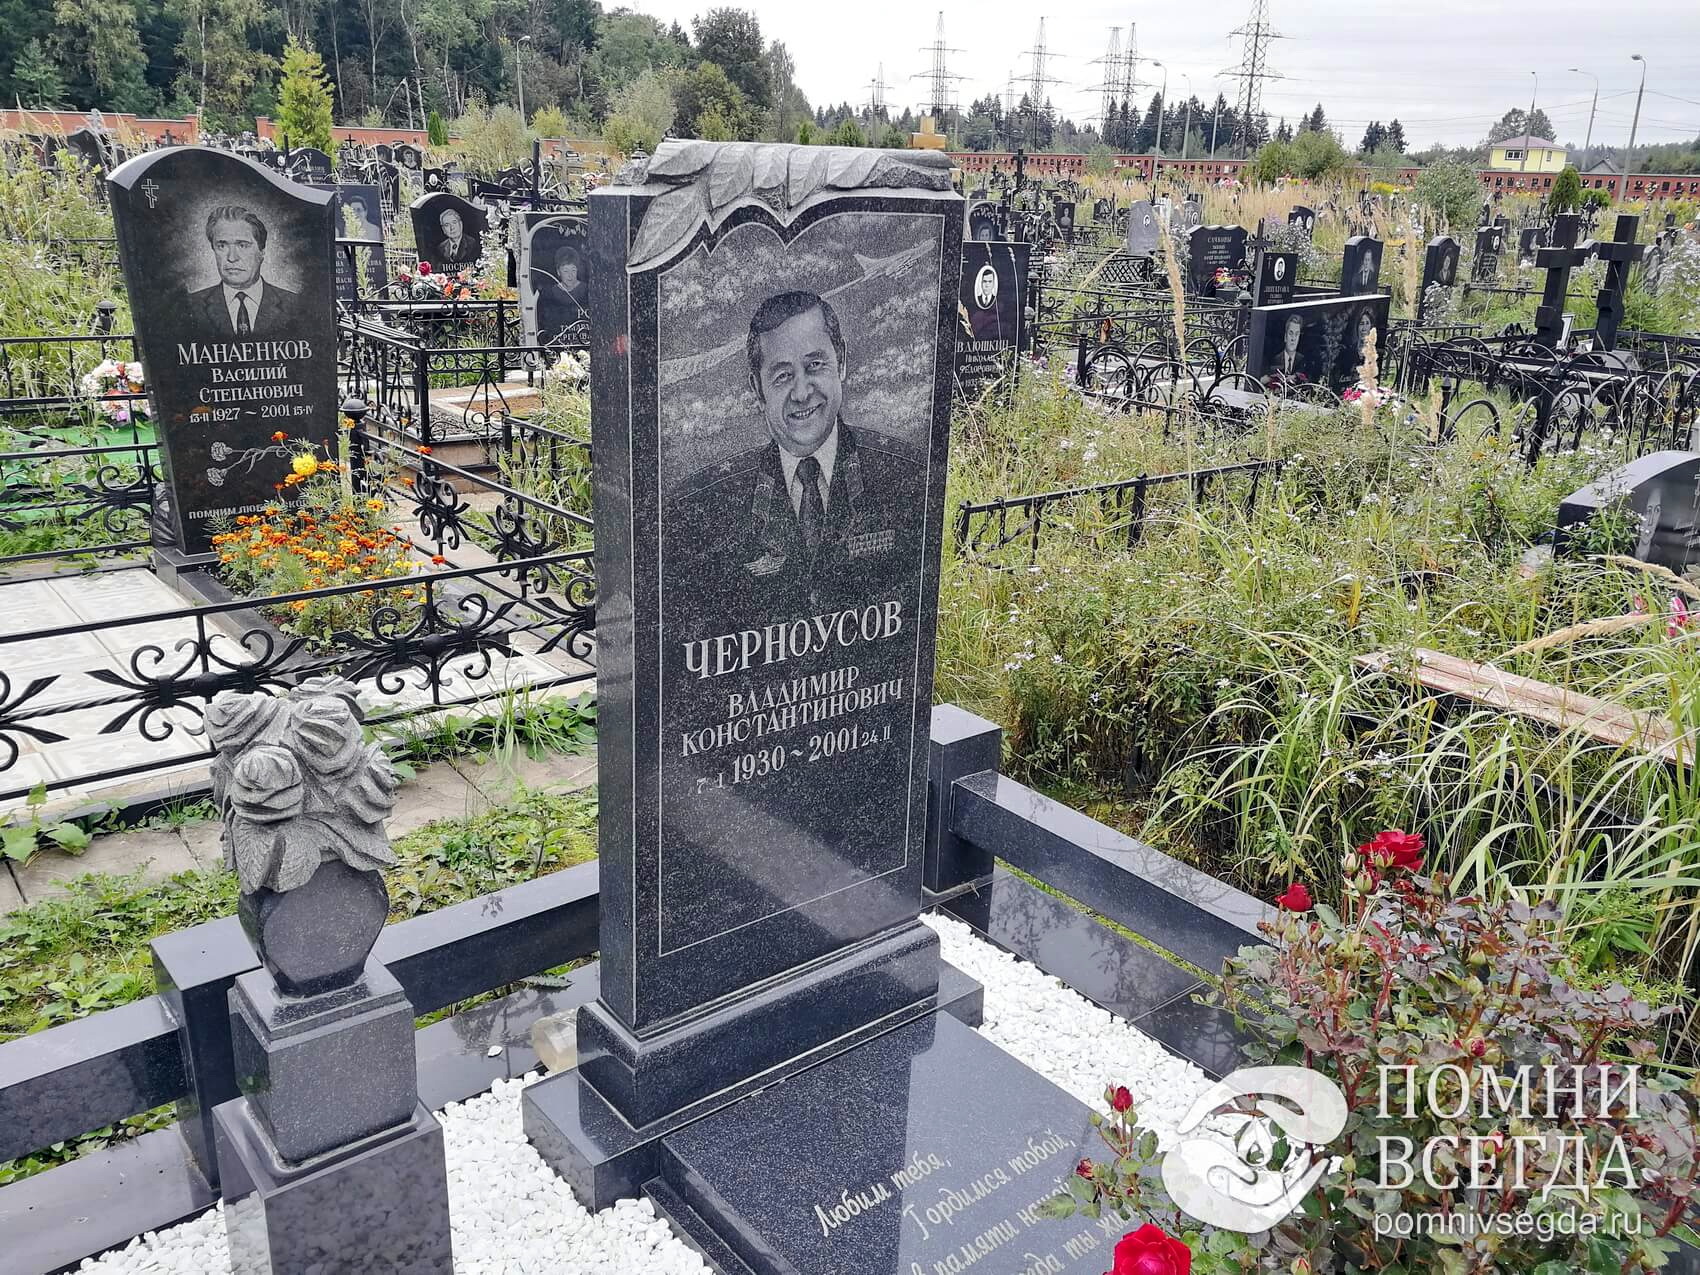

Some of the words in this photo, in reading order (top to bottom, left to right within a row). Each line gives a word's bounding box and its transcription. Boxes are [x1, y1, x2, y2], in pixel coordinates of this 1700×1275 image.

[177, 340, 312, 365] МАНАЕНКОВ
[211, 363, 287, 383] ВАСИЛИЙ
[199, 384, 303, 403] СТЕПАНОВИЧ
[212, 407, 241, 422] 1927
[260, 404, 290, 418] 2001
[682, 600, 902, 680] ЧЕРНОУСОВ
[681, 678, 903, 757] КОНСТАНТИНОВИЧ
[728, 666, 860, 718] ВЛАДИМИР
[732, 745, 785, 784] 1930
[808, 724, 858, 762] 2001
[814, 1189, 892, 1237] Любим
[890, 1151, 953, 1191] тебя,
[902, 1166, 1011, 1240] Гордимся
[1008, 1128, 1076, 1175] тобой,
[932, 1218, 1021, 1275] памяти
[1062, 1229, 1101, 1260] ты
